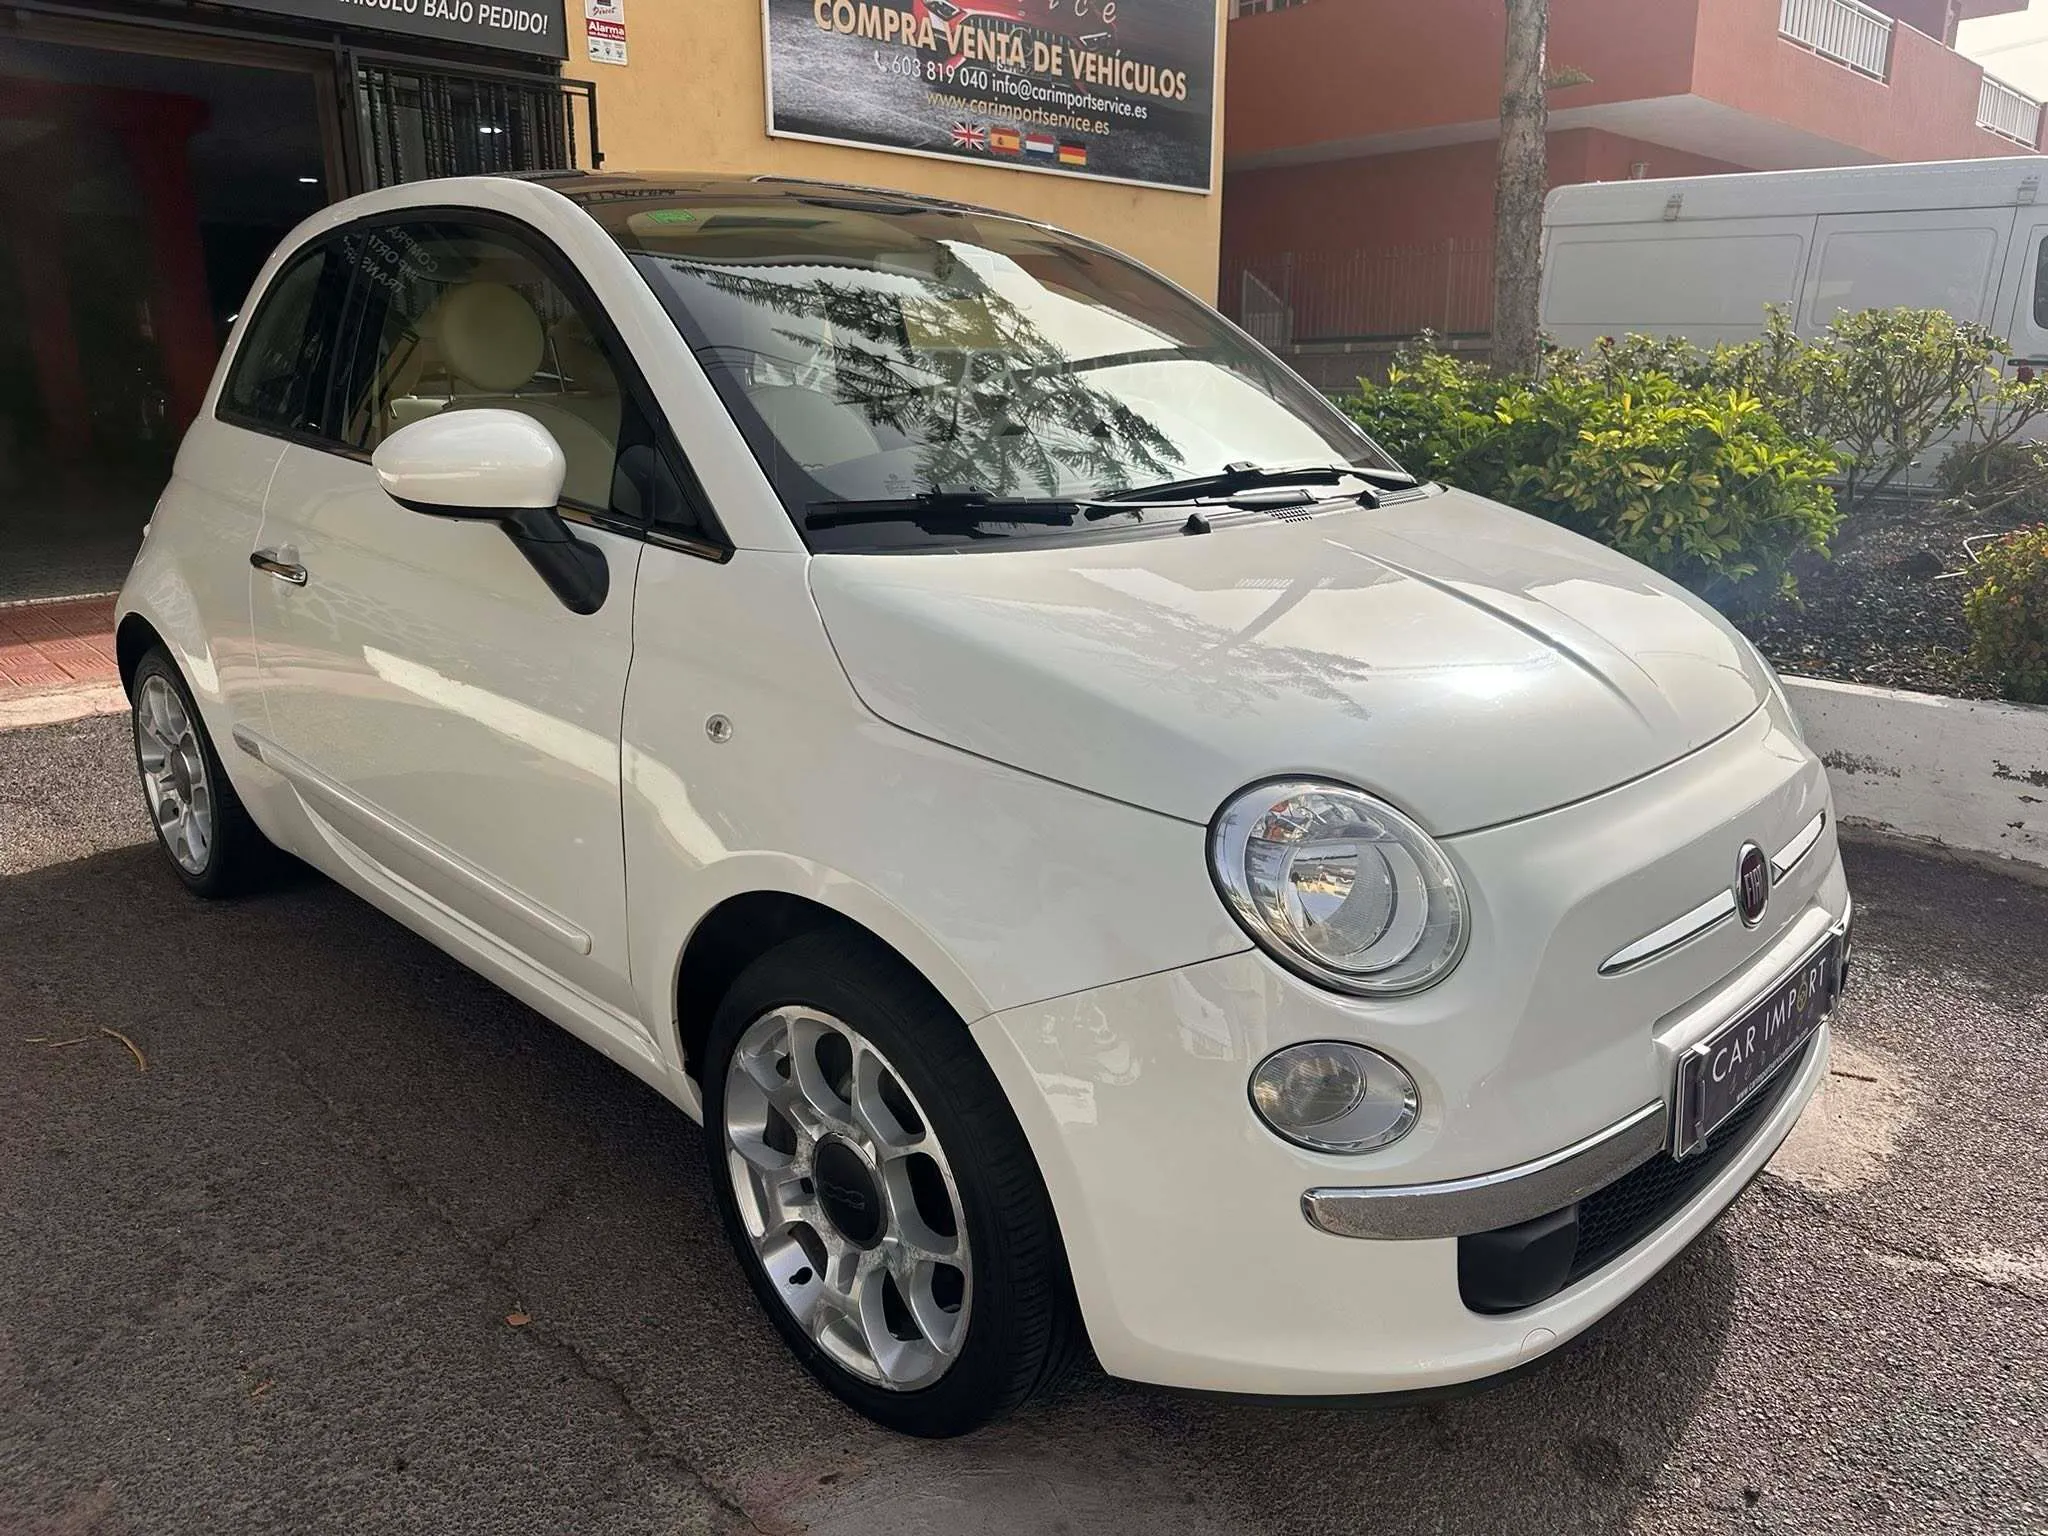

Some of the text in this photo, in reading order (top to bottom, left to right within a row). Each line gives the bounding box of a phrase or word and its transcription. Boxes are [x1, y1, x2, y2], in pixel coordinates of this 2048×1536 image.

[424, 0, 473, 23] BAJO
[478, 4, 548, 35] PEDIDO!
[589, 21, 625, 36] Alarma
[814, 0, 1187, 101] COMPRA VENTA DE VEHÍCULOS
[892, 55, 1148, 119] 603 819 040 info@carimportservice.es
[927, 92, 1110, 135] www.carimportservice.es
[1744, 864, 1761, 908] FIAT
[1712, 1025, 1756, 1083] CAR
[1764, 957, 1827, 1041] IMPORT
